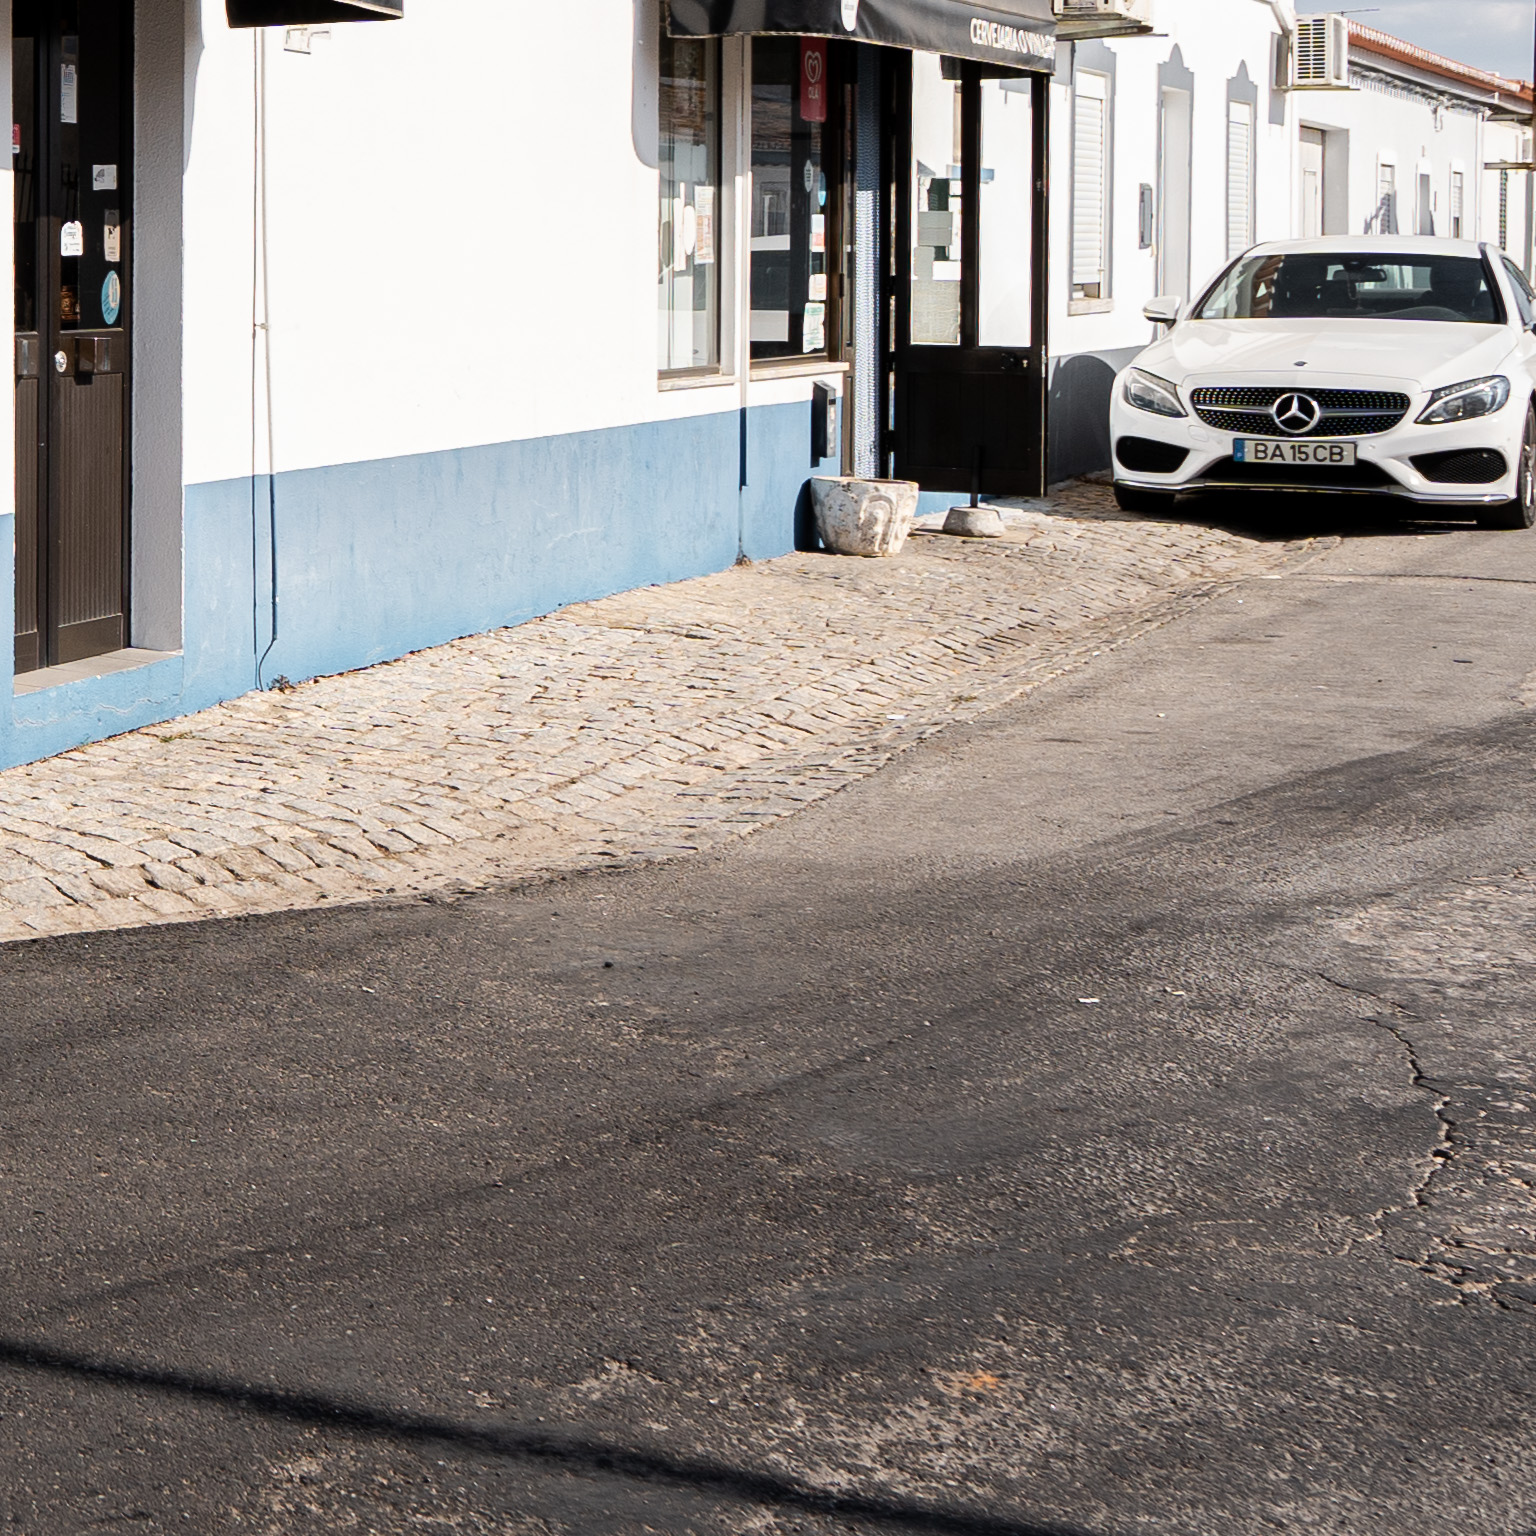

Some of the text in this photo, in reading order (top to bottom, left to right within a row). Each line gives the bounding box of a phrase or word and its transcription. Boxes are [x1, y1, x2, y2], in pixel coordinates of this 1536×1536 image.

[1254, 443, 1344, 462] BA 15 CB
